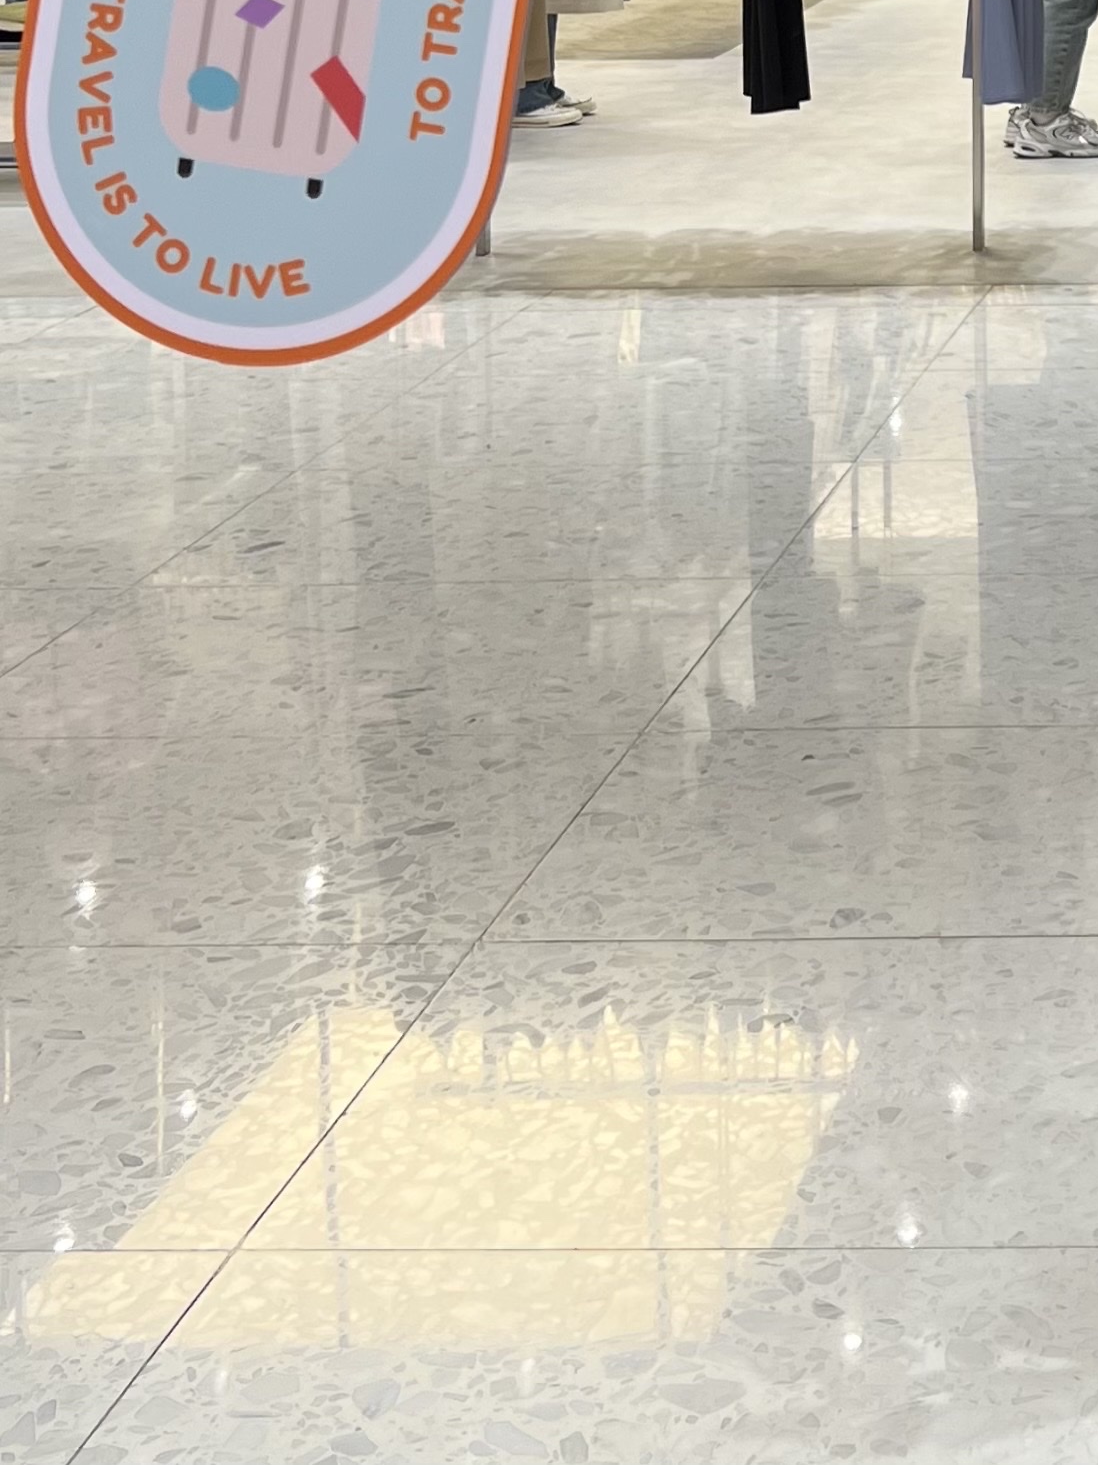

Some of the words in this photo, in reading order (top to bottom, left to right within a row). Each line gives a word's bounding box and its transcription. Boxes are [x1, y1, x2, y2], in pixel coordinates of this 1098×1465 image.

[409, 77, 451, 141] TO
[95, 171, 138, 215] IS
[132, 213, 190, 274] TO
[199, 256, 311, 300] LIVE
